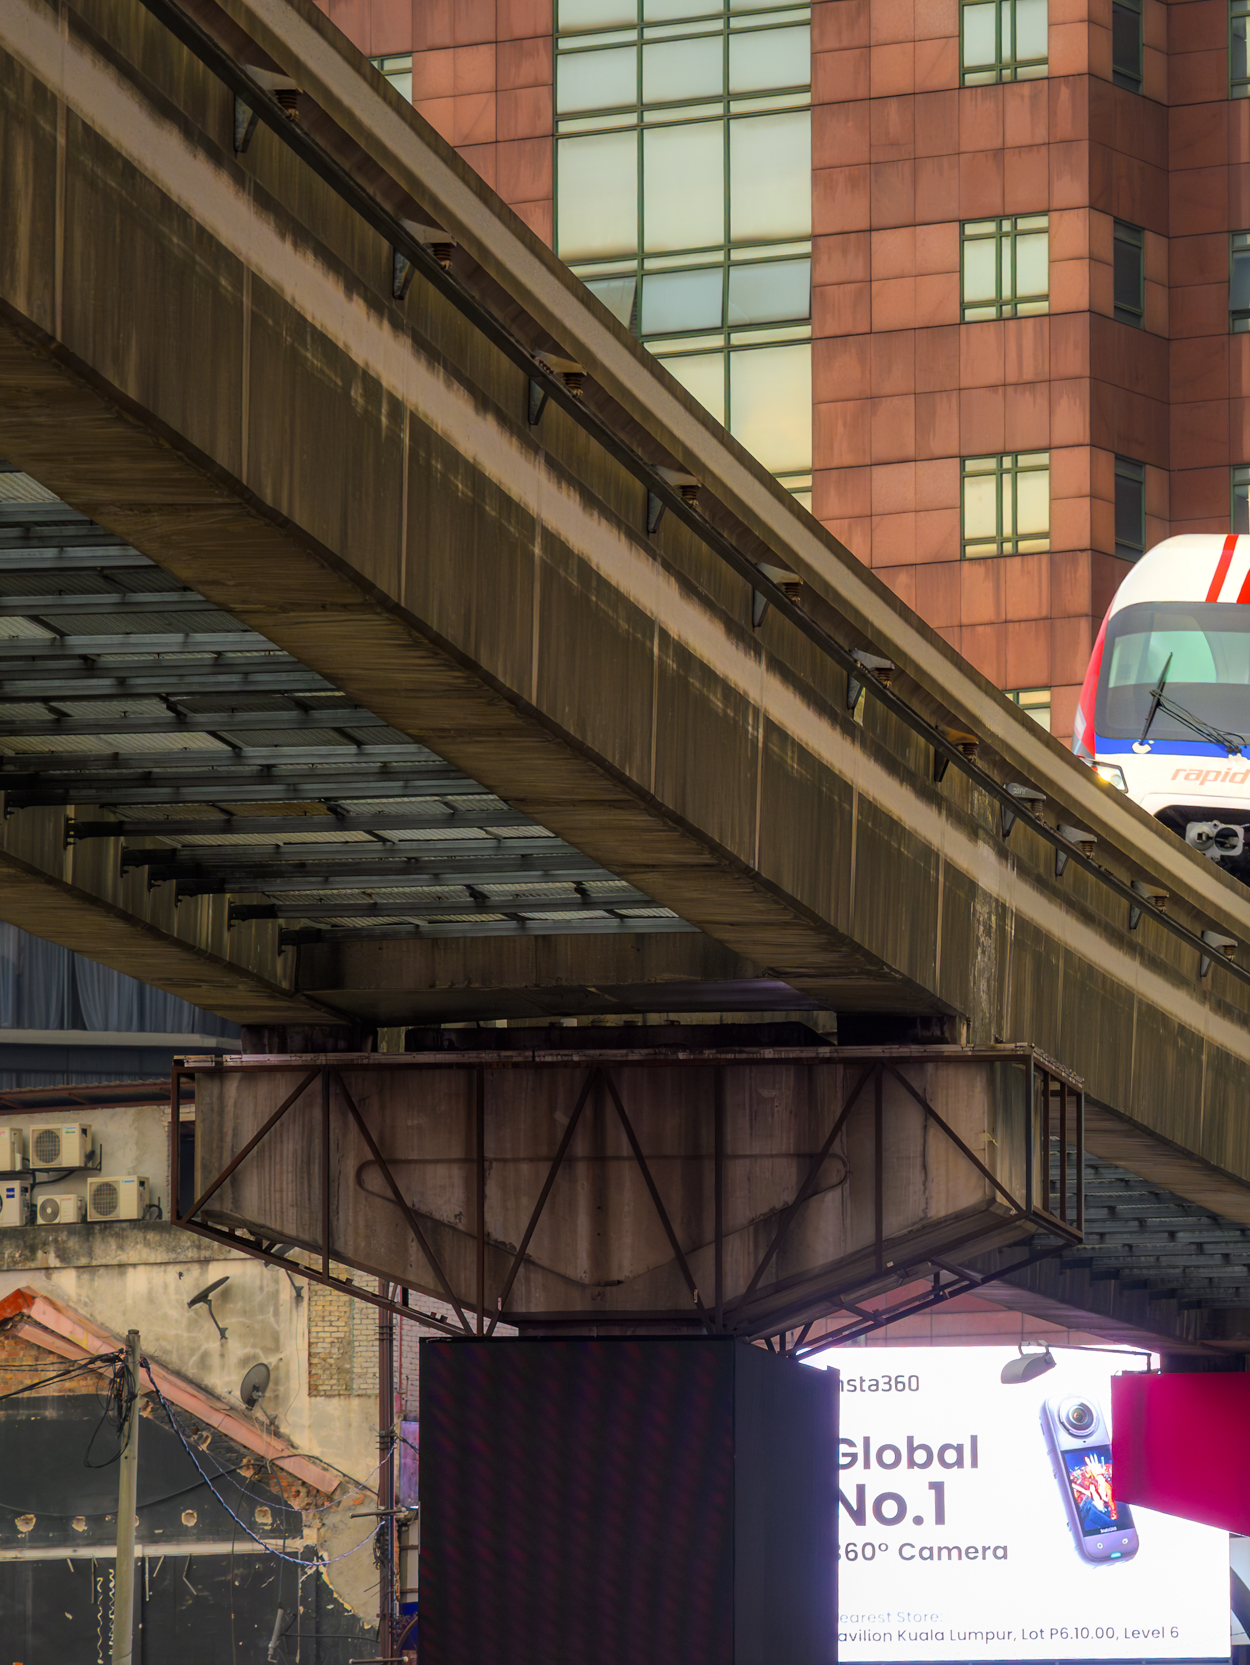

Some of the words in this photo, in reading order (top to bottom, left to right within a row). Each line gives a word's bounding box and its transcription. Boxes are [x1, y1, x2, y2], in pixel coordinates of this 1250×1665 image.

[838, 1434, 979, 1470] Global
[838, 1481, 946, 1526] No.1
[838, 1542, 889, 1562] 60°
[898, 1542, 1008, 1561] Camera
[897, 1611, 943, 1624] Store:
[897, 1629, 945, 1642] Kuala
[949, 1629, 1018, 1645] Lumpur,
[1022, 1628, 1045, 1641] Lot
[1050, 1626, 1119, 1641] P6.10.00,
[1124, 1626, 1165, 1640] Level
[1170, 1625, 1179, 1639] 6
